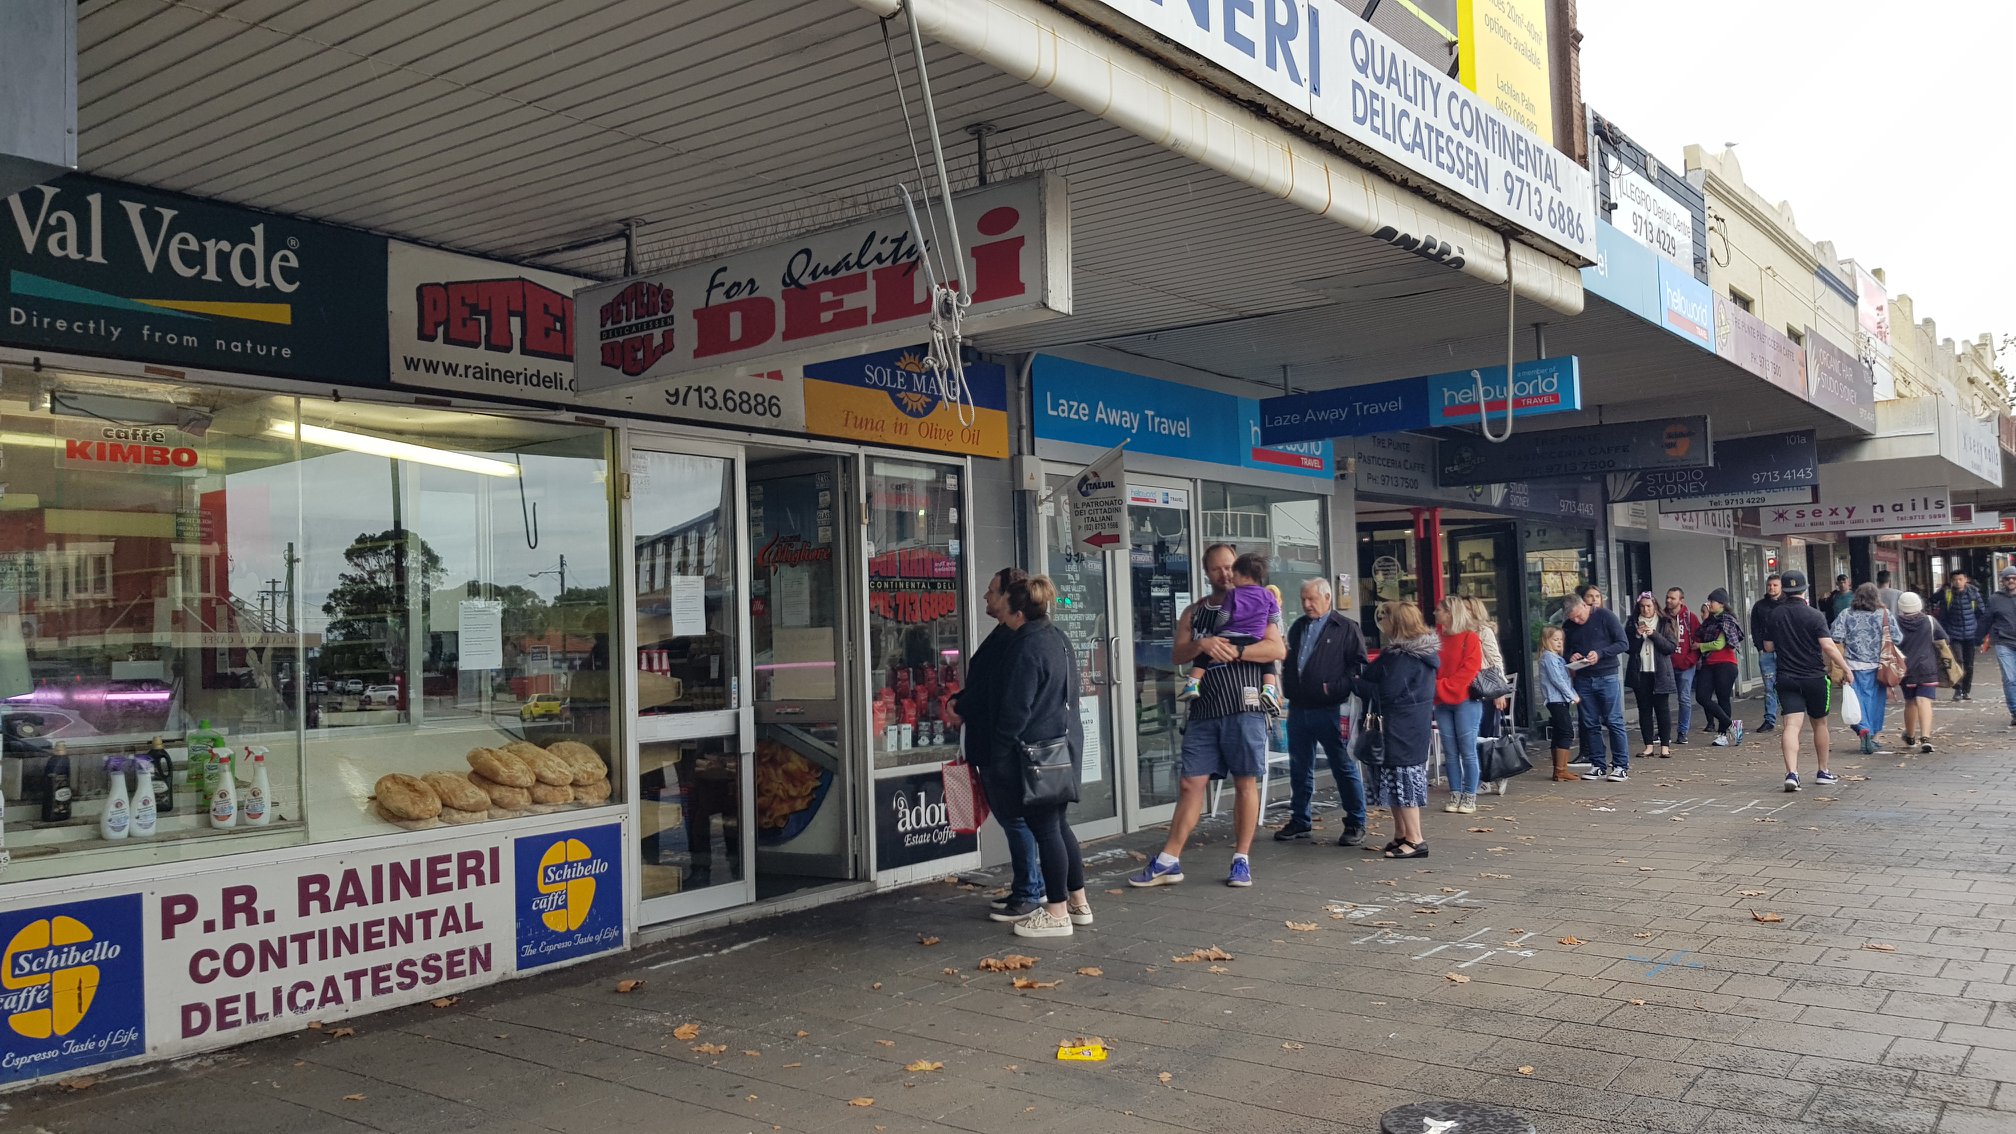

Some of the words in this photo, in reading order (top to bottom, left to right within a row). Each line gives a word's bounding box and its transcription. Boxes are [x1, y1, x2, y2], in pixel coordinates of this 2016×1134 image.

[1485, 13, 1512, 45] options
[1496, 73, 1521, 102] Lachlan
[1521, 92, 1536, 116] Palm
[1349, 28, 1441, 118] QUALITY
[1446, 90, 1562, 194] CONTINENTAL
[1352, 79, 1490, 195] DELICATESSEN
[1503, 170, 1544, 222] 9713
[1547, 200, 1586, 245] 6886
[8, 184, 108, 265] Val
[1632, 211, 1654, 244] 9713
[1656, 228, 1676, 258] 4229
[705, 267, 760, 308] For
[781, 231, 930, 290] Quality
[600, 281, 674, 328] PETER'S
[10, 307, 123, 341] Directly
[142, 325, 199, 347] from
[216, 338, 293, 359] nature
[602, 318, 673, 340] DELICATESSEN
[601, 329, 675, 377] DELI
[864, 364, 907, 389] SOLE
[1264, 411, 1301, 428] Laze
[1304, 404, 1348, 425] Away
[1352, 397, 1403, 417] Travel
[1521, 396, 1555, 406] TRAVEL
[1046, 391, 1089, 421] Laze
[1095, 401, 1140, 434] Away
[1144, 410, 1191, 438] Travel
[101, 426, 166, 443] caffé
[843, 409, 885, 431] Tuna
[894, 417, 908, 435] in
[918, 421, 953, 442] Olive
[961, 428, 980, 446] Oil
[1785, 435, 1807, 445] 101a
[65, 439, 199, 468] KIMBO
[1301, 457, 1321, 469] TRAVEL
[1085, 481, 1116, 491] ITALUIL
[1380, 474, 1399, 488] 9713
[1400, 476, 1419, 490] 7500
[1646, 469, 1704, 485] STUDIO
[1752, 472, 1780, 484] 9713
[1783, 467, 1813, 480] 4143
[1647, 481, 1708, 497] SYDNEY
[1725, 498, 1745, 506] 9713
[1747, 496, 1766, 505] 4229
[1082, 499, 1124, 508] PATRONATO
[1088, 507, 1122, 516] CITTADINI
[1560, 500, 1577, 513] 9713
[1577, 502, 1594, 516] 4143
[1795, 506, 1857, 519] sexy
[1872, 497, 1945, 514] nails
[1084, 515, 1114, 524] ITALIANI
[1704, 509, 1731, 529] nails
[869, 581, 931, 589] CONTINENTAL
[892, 790, 948, 832] ador
[904, 834, 931, 847] Estate
[545, 858, 609, 883] Schibello
[161, 885, 275, 940] P.R.
[298, 846, 501, 918] RAINERI
[532, 890, 567, 912] caffé
[188, 901, 484, 984] CONTINENTAL
[521, 941, 537, 957] The
[539, 940, 572, 955] Espresso
[573, 933, 593, 945] Taste
[594, 928, 604, 944] of
[602, 925, 620, 940] Life
[15, 941, 121, 975] Schibello
[181, 942, 493, 1039] DELICATESSEN
[2, 1052, 59, 1070] Espresso
[62, 1038, 97, 1056] Taste
[98, 1030, 114, 1053] of
[110, 1027, 139, 1048] Life
